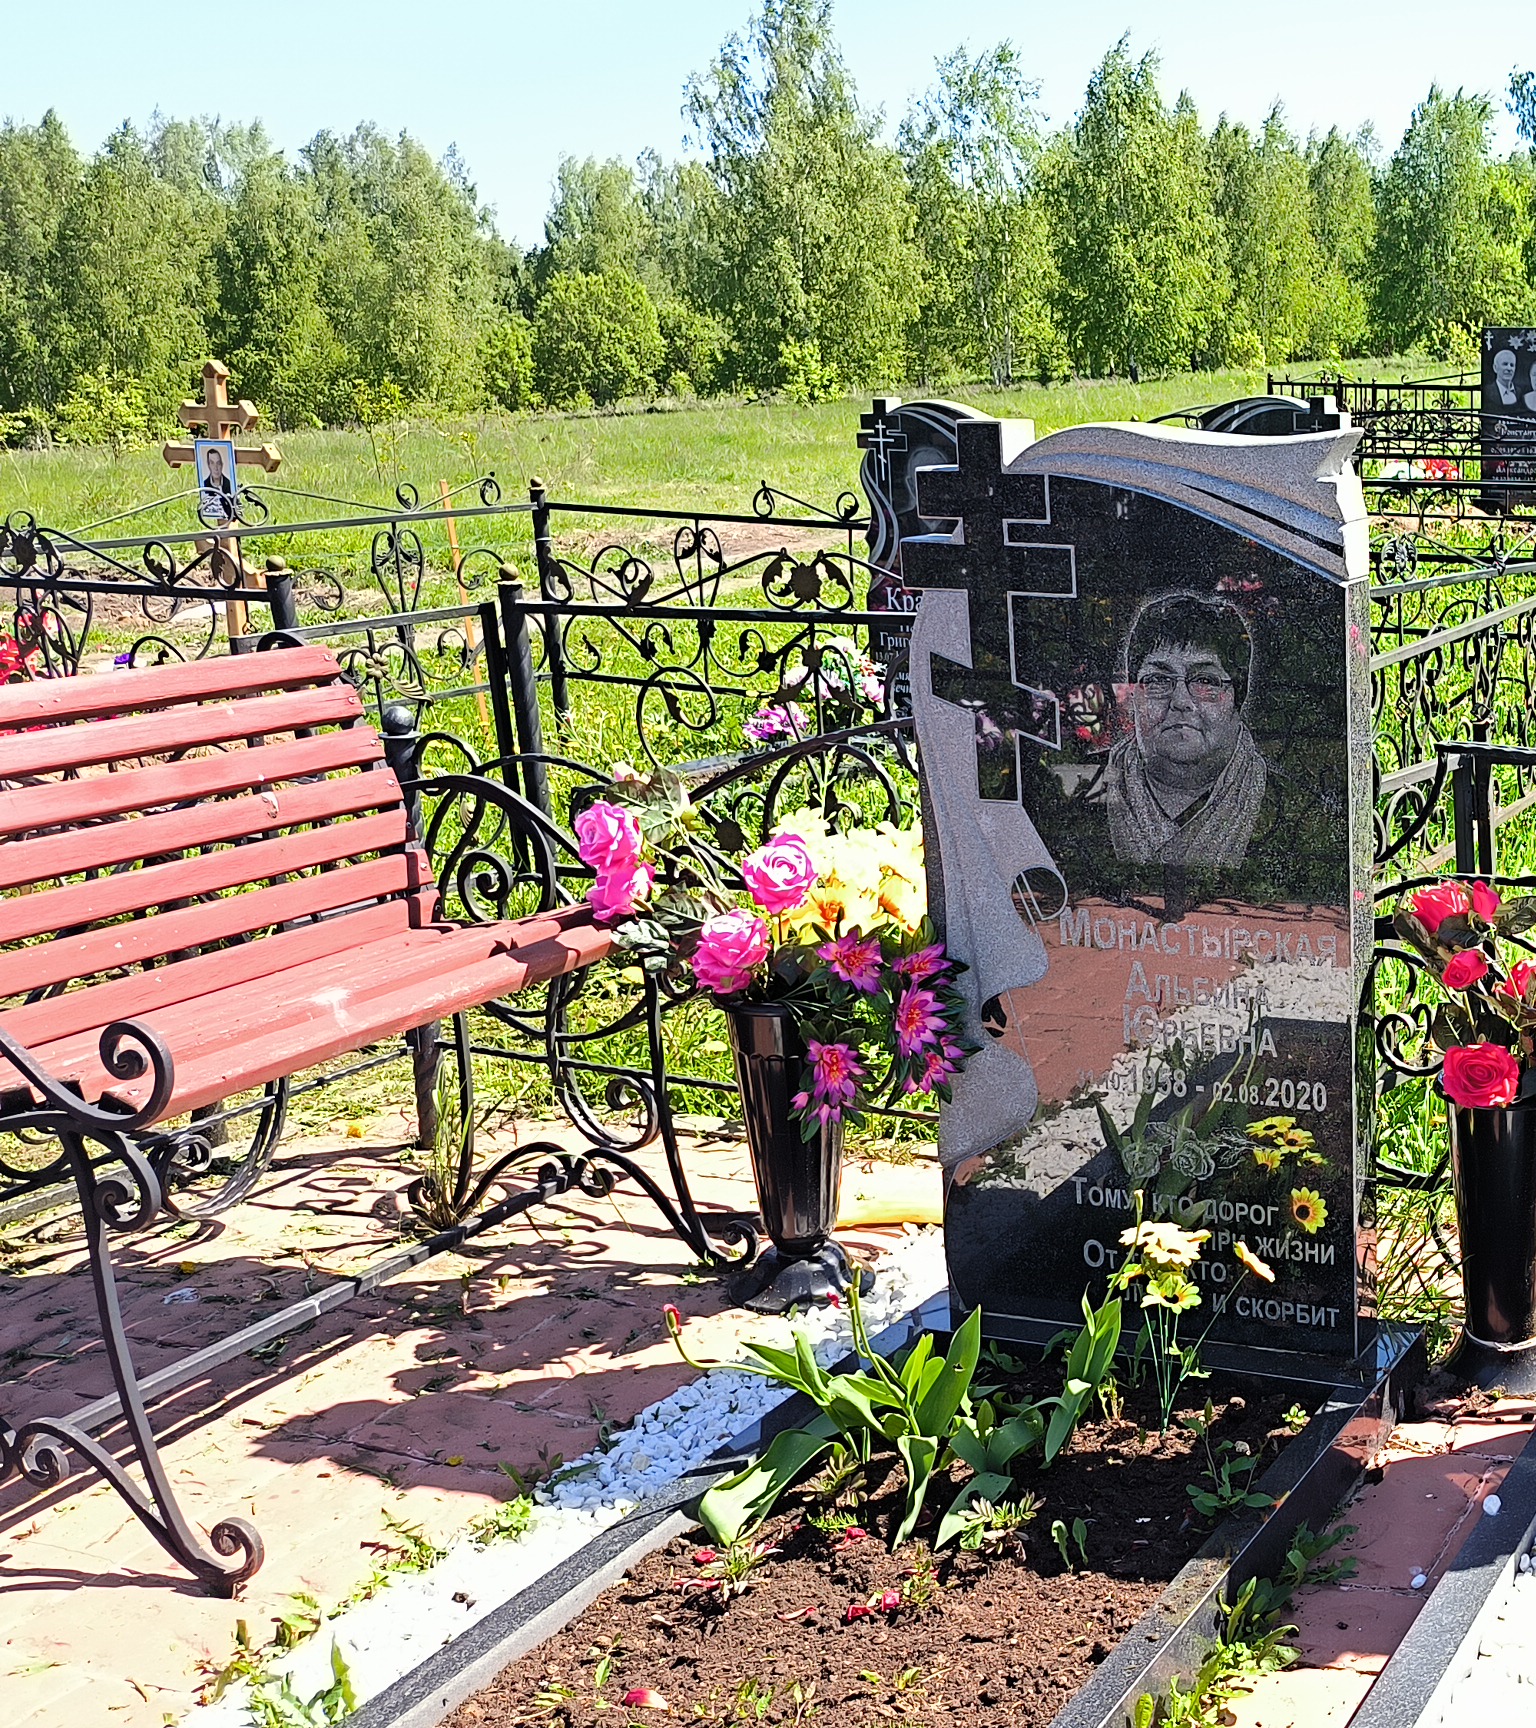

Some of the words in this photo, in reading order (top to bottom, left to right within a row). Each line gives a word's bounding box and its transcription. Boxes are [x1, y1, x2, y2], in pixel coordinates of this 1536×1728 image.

[1060, 907, 1337, 967] МОНАСТЫРСКАЯ
[1203, 1199, 1280, 1226] ДОРОГ
[1255, 1234, 1335, 1266] ЖИЗНИ
[1235, 1296, 1340, 1328] СКОРБИТ
